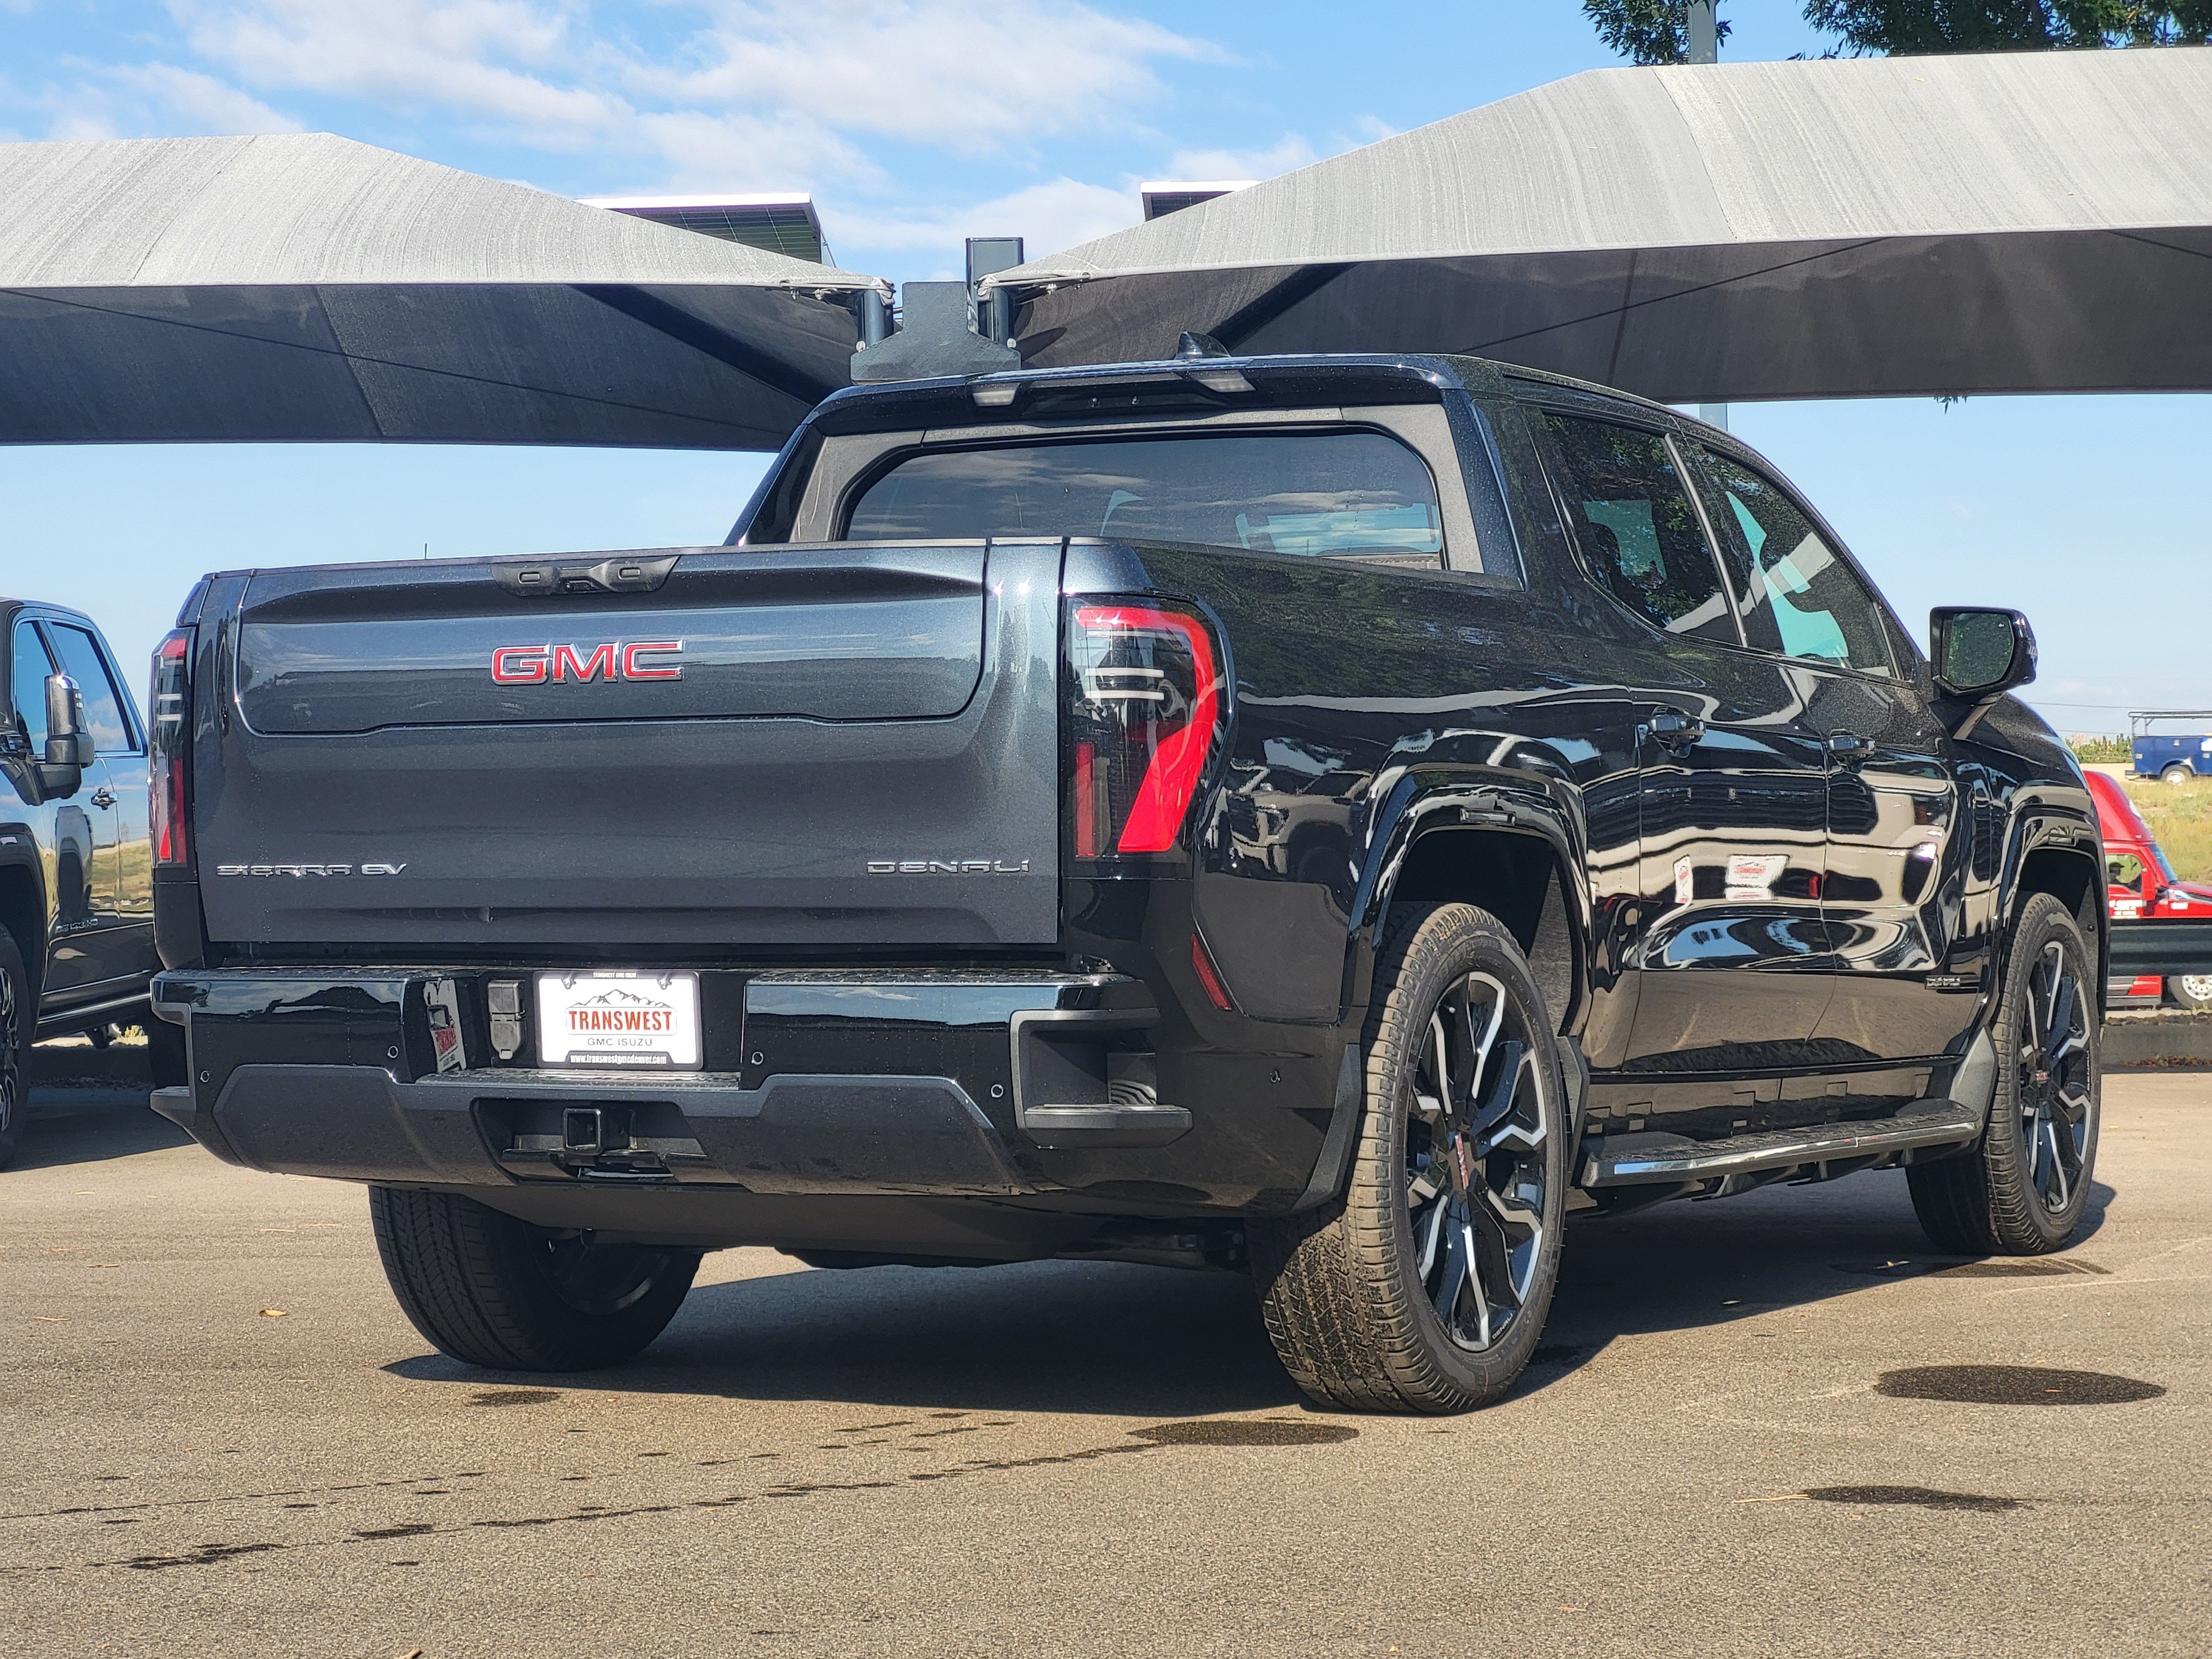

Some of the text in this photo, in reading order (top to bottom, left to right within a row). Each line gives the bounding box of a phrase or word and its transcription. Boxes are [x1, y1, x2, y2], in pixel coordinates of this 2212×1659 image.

[491, 639, 686, 686] GMC
[217, 863, 407, 877] SIERRA EV
[867, 859, 1030, 873] DENALI
[568, 1011, 672, 1031] TRANSWEST
[587, 1038, 653, 1047] GMC ISUZU
[1492, 1312, 1514, 1339] DENALI
